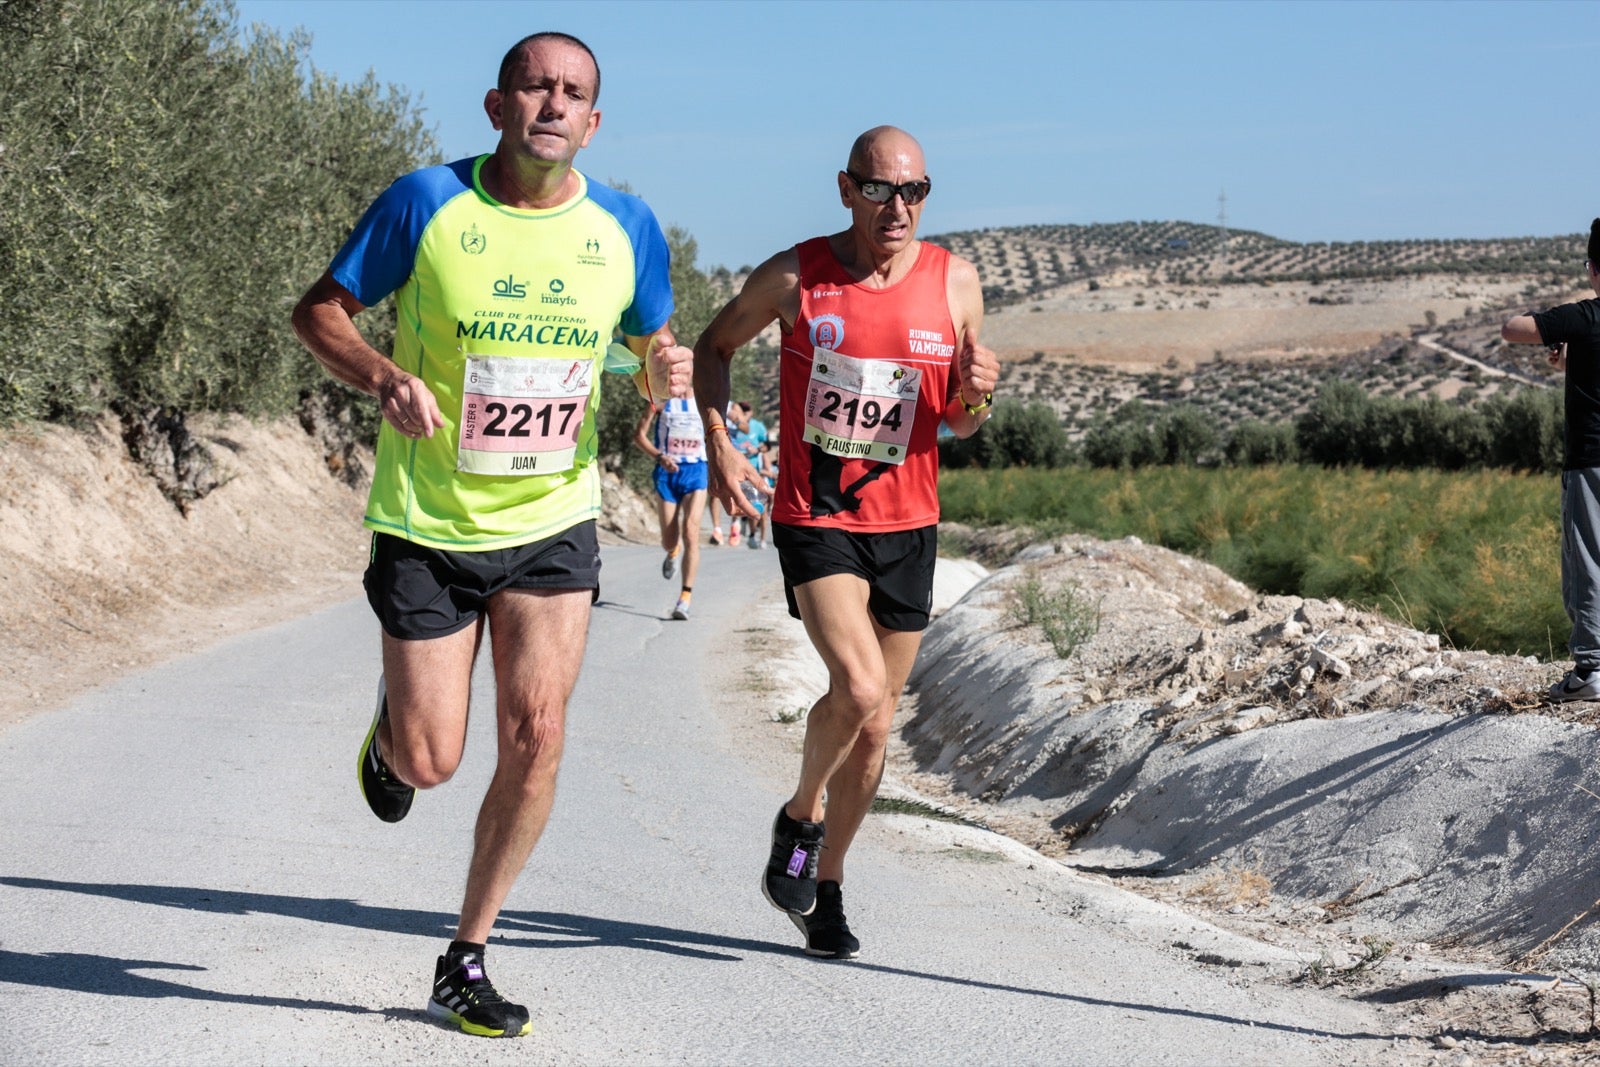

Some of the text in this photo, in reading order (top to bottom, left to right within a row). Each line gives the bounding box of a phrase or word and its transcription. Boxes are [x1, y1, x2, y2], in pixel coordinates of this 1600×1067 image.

[492, 274, 527, 298] als
[541, 295, 577, 306] mayfo
[474, 310, 586, 324] CLUB DE ATLETISMO
[456, 320, 599, 348] MARACENA
[909, 329, 943, 342] RUNNING
[908, 340, 955, 357] VAMPIROS
[807, 393, 818, 418] MASTER
[819, 390, 902, 432] 2194
[465, 410, 477, 440] MASTER
[482, 402, 578, 437] 2217
[673, 439, 699, 449] 2172
[826, 438, 872, 455] FAUSTINO
[510, 456, 537, 470] JUAN
